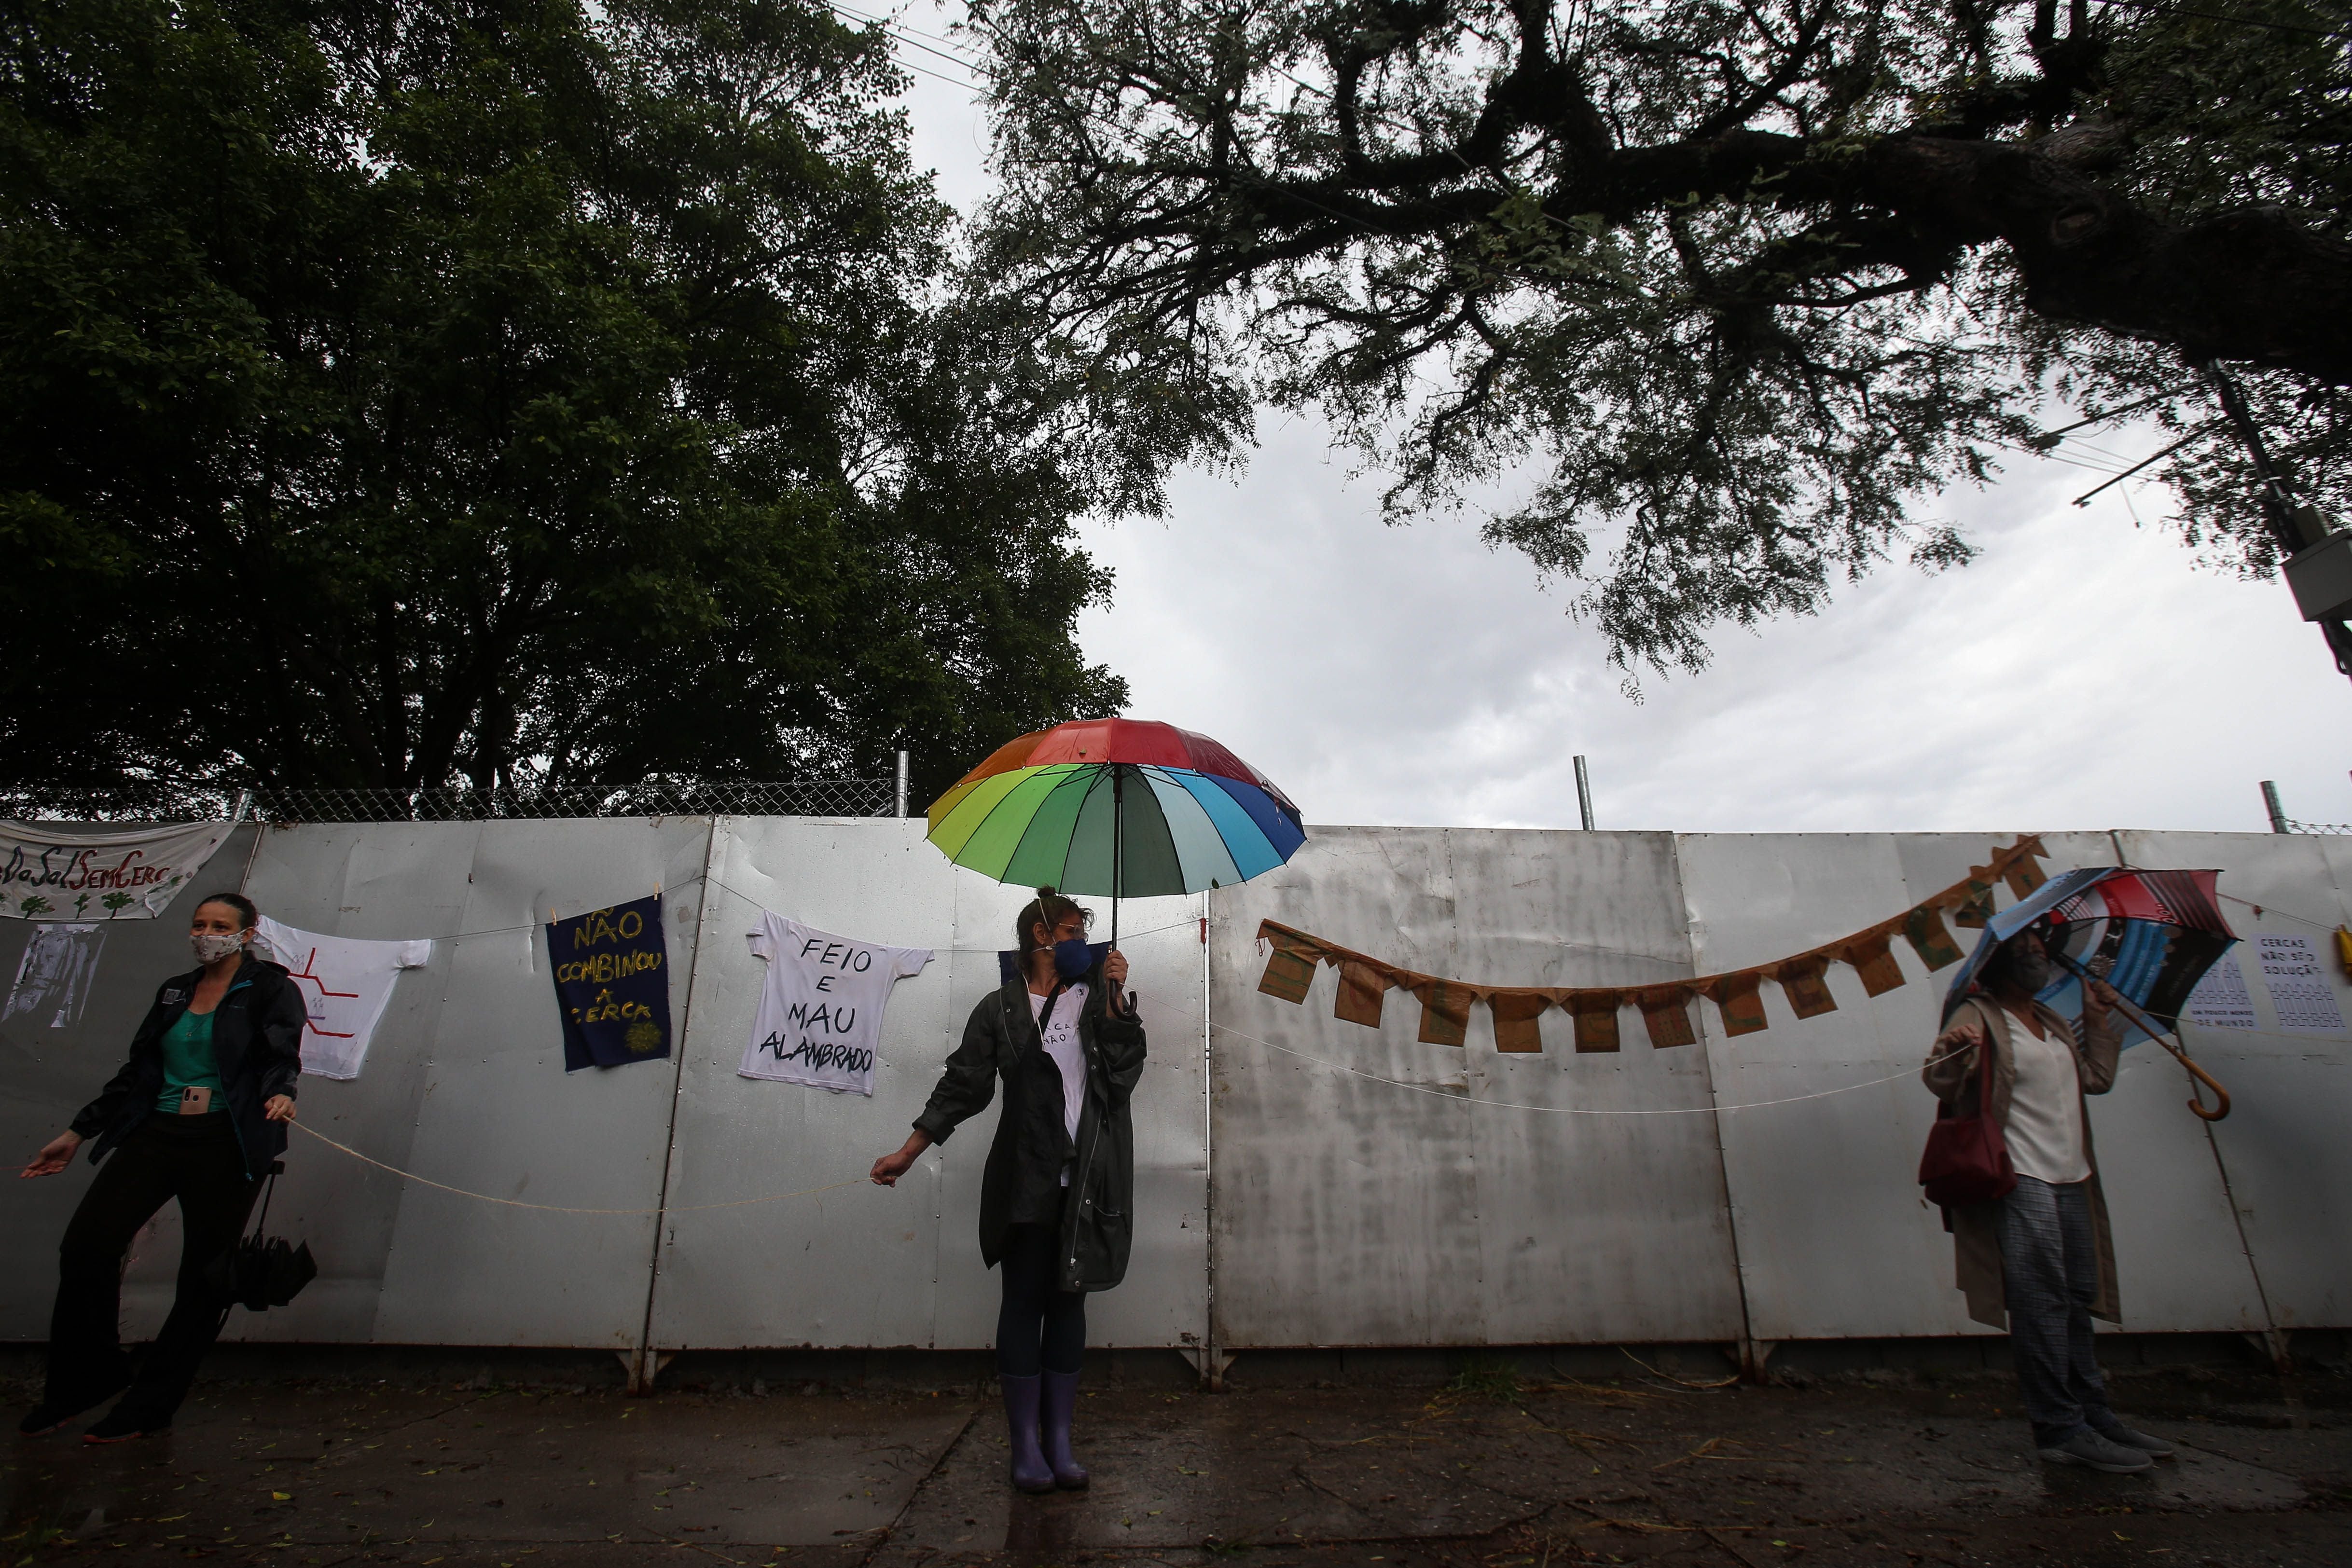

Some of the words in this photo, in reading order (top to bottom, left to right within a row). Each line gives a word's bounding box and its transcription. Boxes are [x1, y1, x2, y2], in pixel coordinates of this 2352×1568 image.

[574, 907, 642, 949] NÃO
[2261, 938, 2306, 948] CERCAS
[557, 949, 662, 983] COMBINOU
[801, 938, 872, 973] FEIO
[816, 976, 836, 992] E
[788, 1003, 855, 1033] MAU
[759, 1031, 873, 1073] ALAMBRADO
